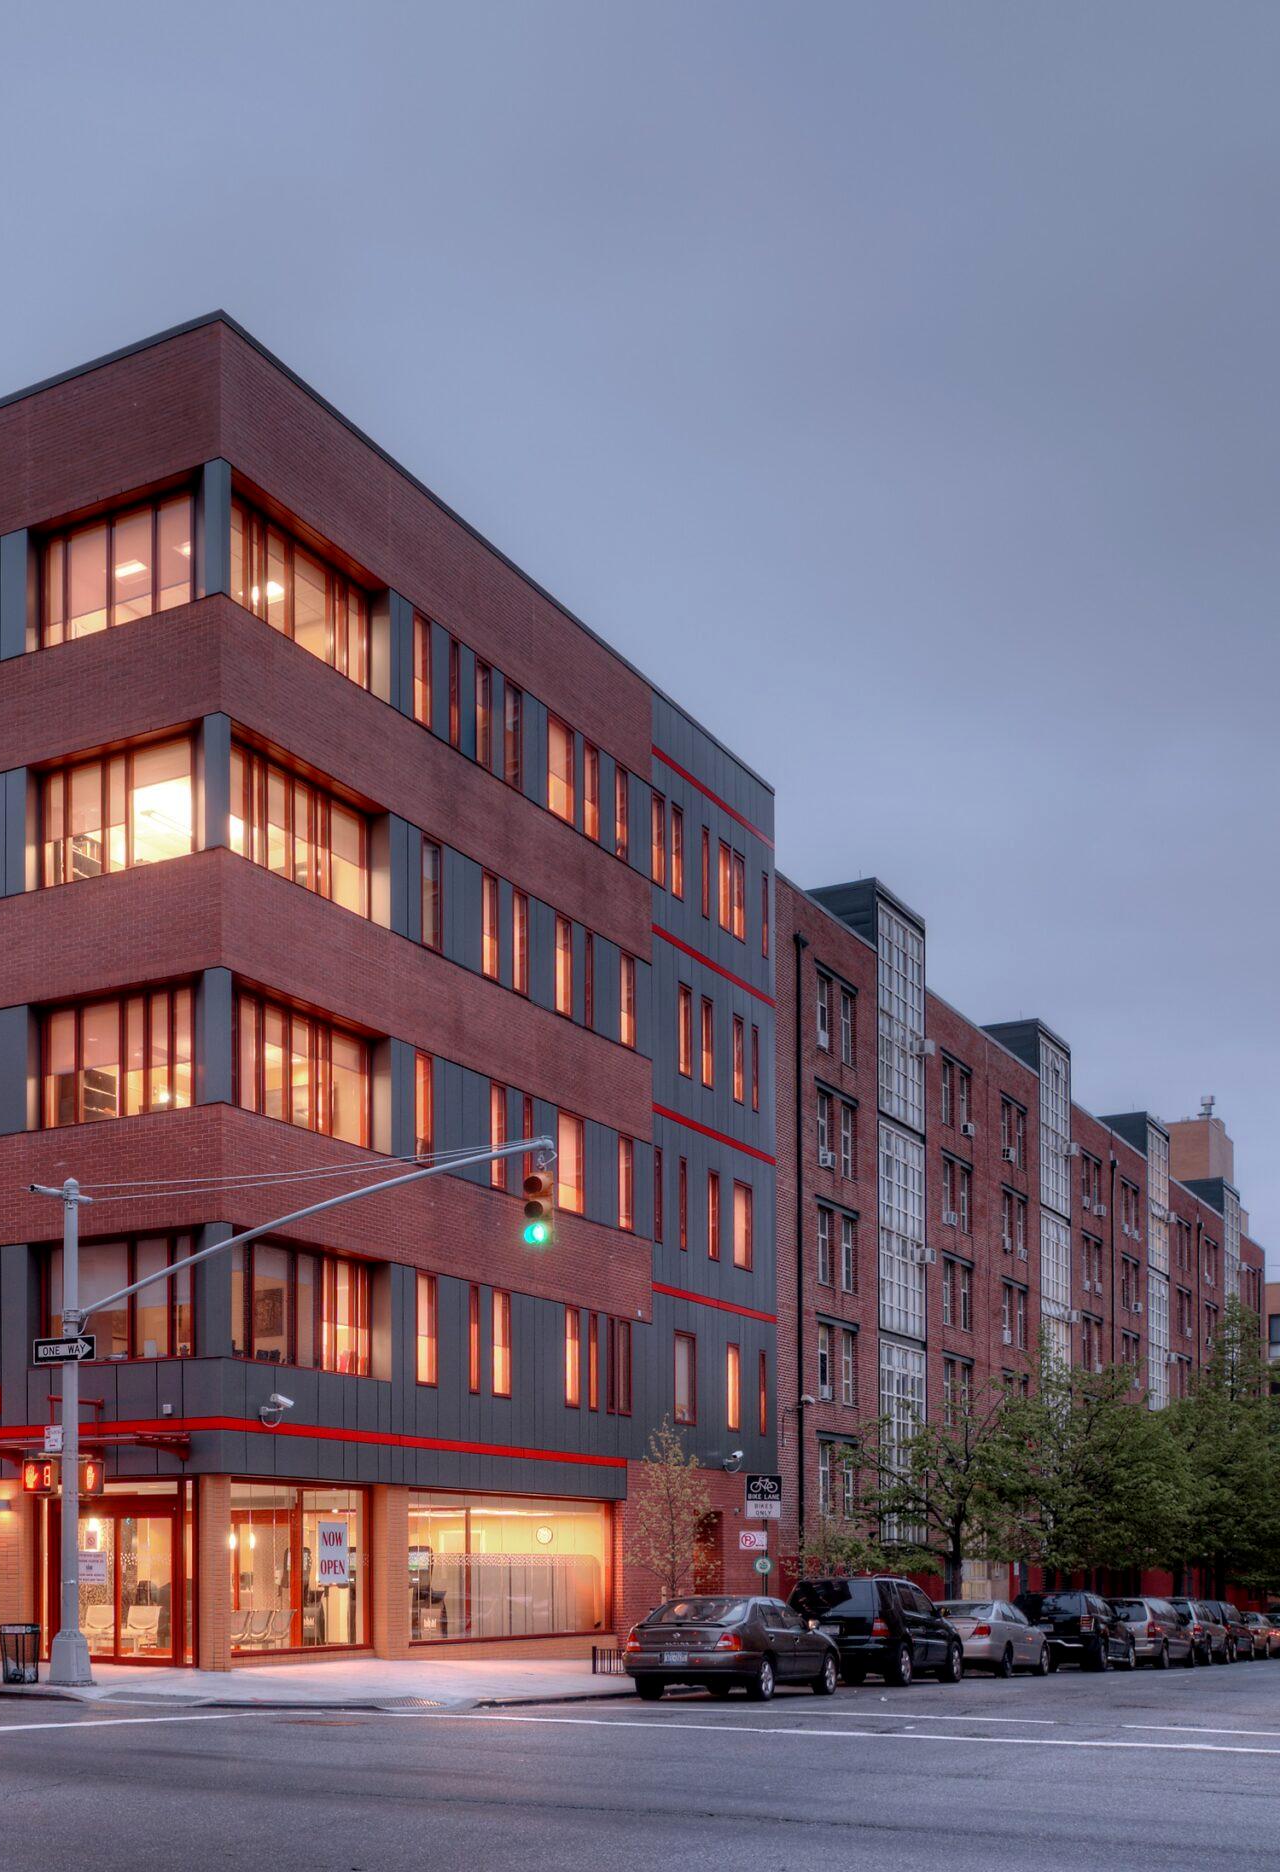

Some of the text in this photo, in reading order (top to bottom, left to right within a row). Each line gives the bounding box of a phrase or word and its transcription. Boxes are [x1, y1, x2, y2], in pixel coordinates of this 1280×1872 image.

[42, 1344, 86, 1356] ONE WAY
[322, 1531, 344, 1547] NOW
[320, 1559, 345, 1575] OPEN
